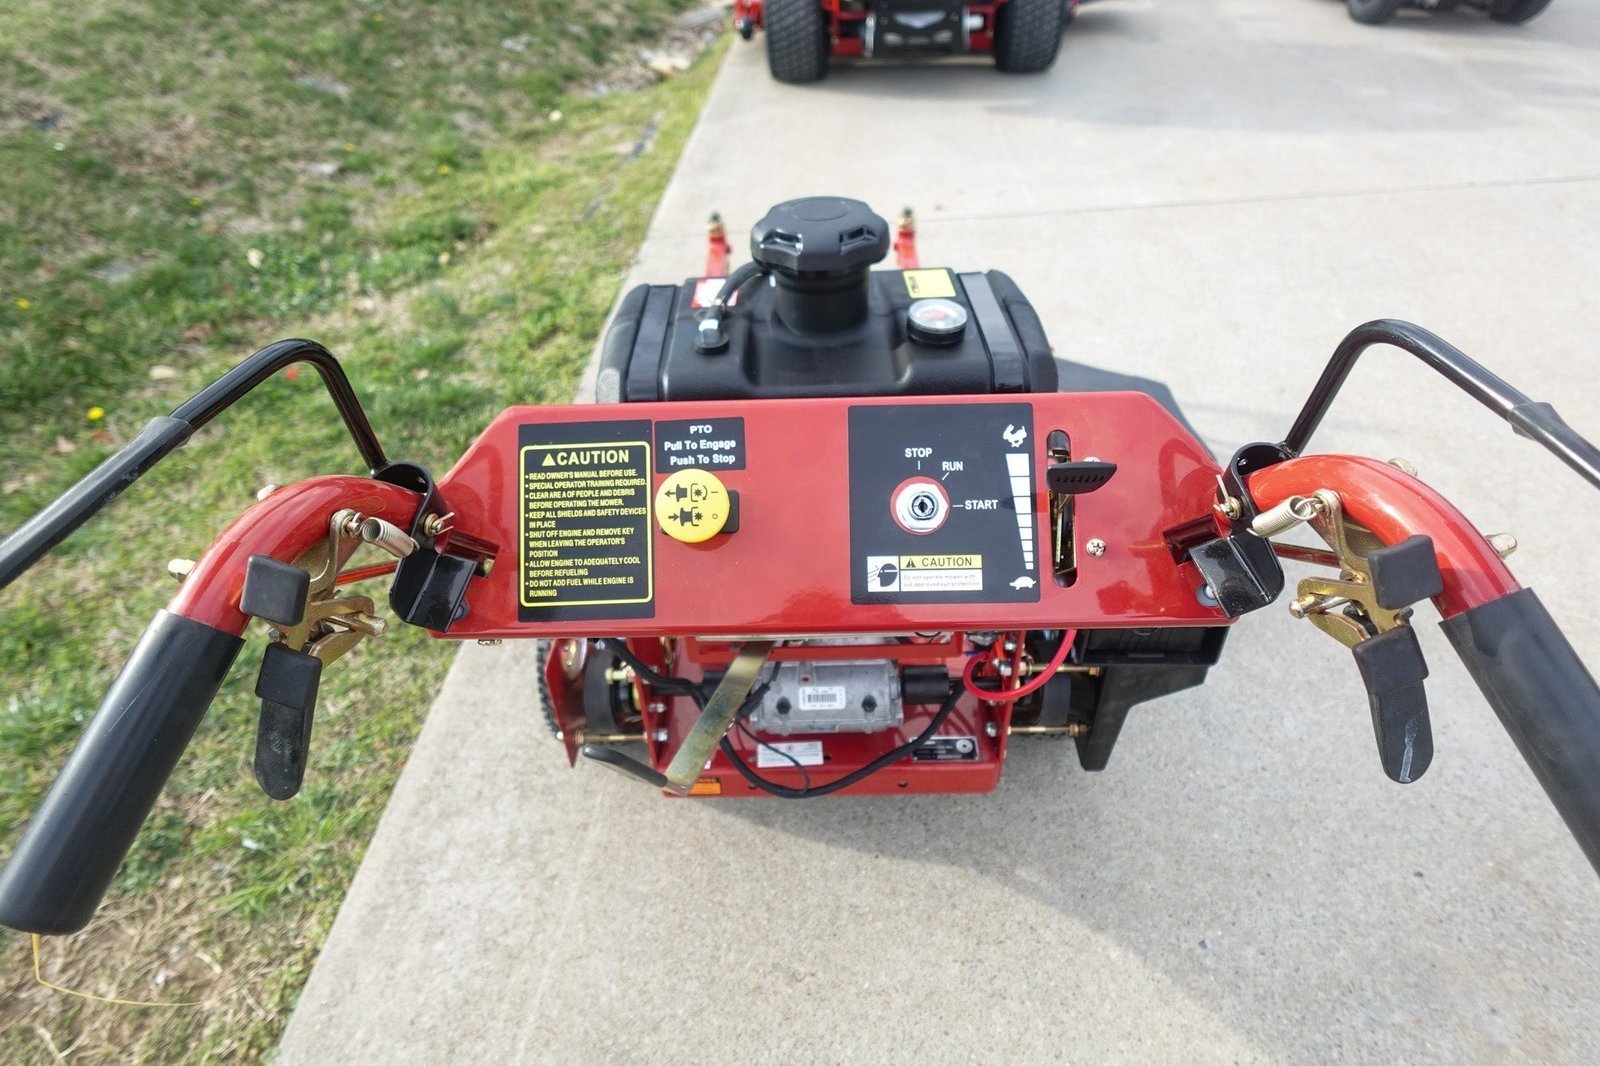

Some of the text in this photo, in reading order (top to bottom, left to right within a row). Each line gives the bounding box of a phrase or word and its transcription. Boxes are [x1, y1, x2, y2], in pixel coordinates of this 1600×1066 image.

[690, 425, 712, 434] PTO
[664, 439, 736, 451] Pull To Engage
[557, 450, 629, 465] CAUTION
[905, 448, 932, 458] STOP
[670, 454, 735, 466] Push To Stop
[942, 461, 963, 471] RUN
[965, 500, 998, 510] START
[922, 557, 972, 567] CAUTION
